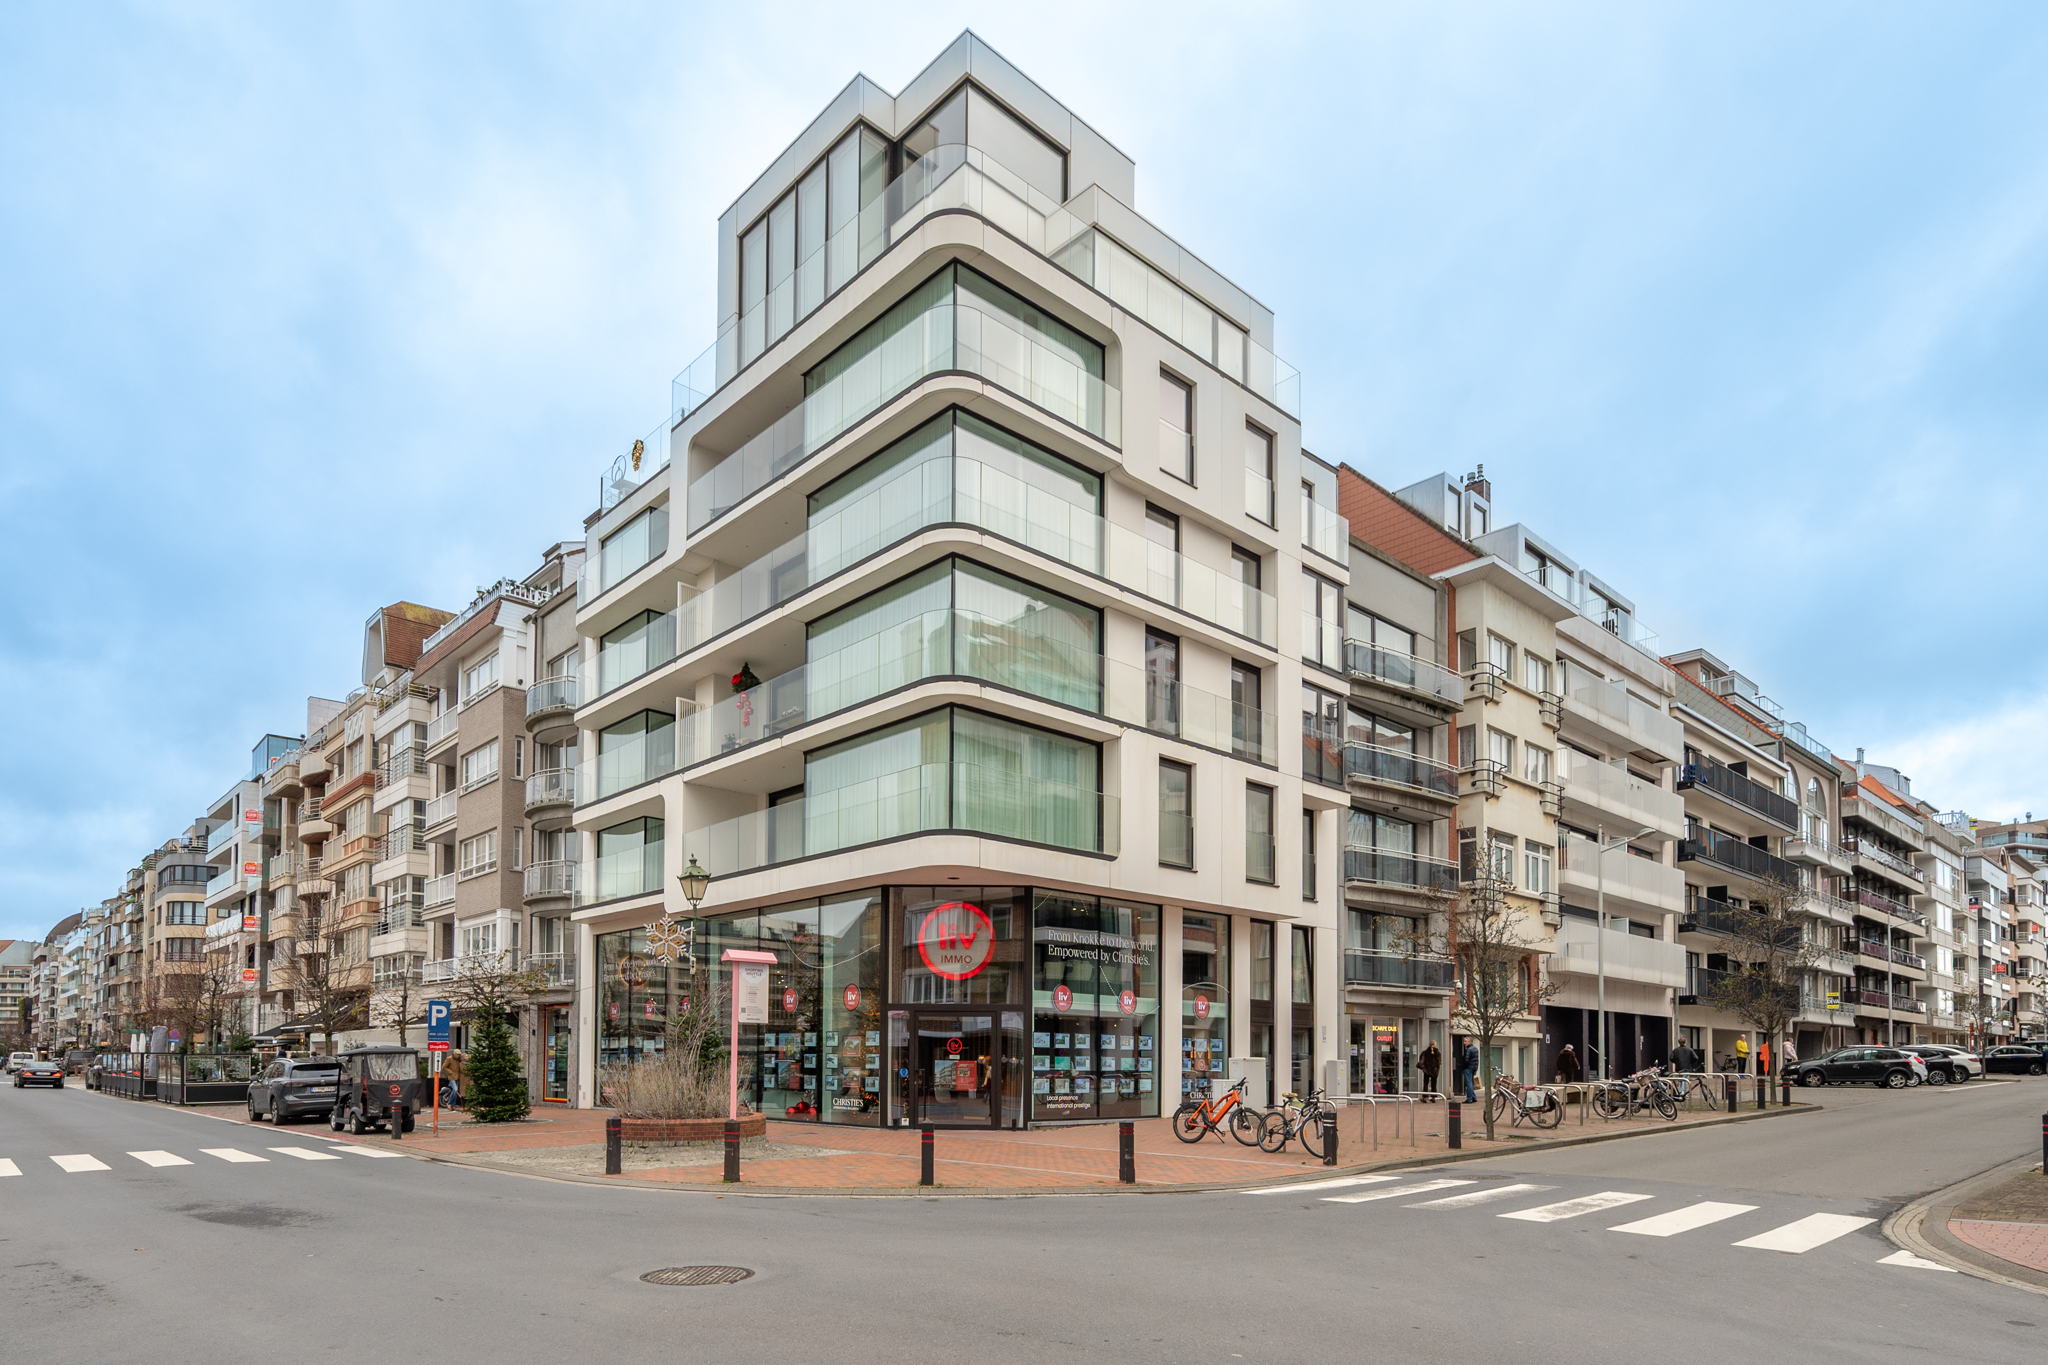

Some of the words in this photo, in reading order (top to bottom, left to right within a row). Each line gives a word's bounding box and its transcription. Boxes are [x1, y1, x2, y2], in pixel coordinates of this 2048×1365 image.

[1048, 930, 1071, 941] From
[1073, 931, 1106, 946] Knokke
[1106, 936, 1115, 947] to
[1115, 936, 1130, 949] the
[941, 955, 973, 964] IMMO
[1048, 944, 1099, 959] Empowered
[1100, 949, 1112, 964] by
[431, 1005, 448, 1026] P
